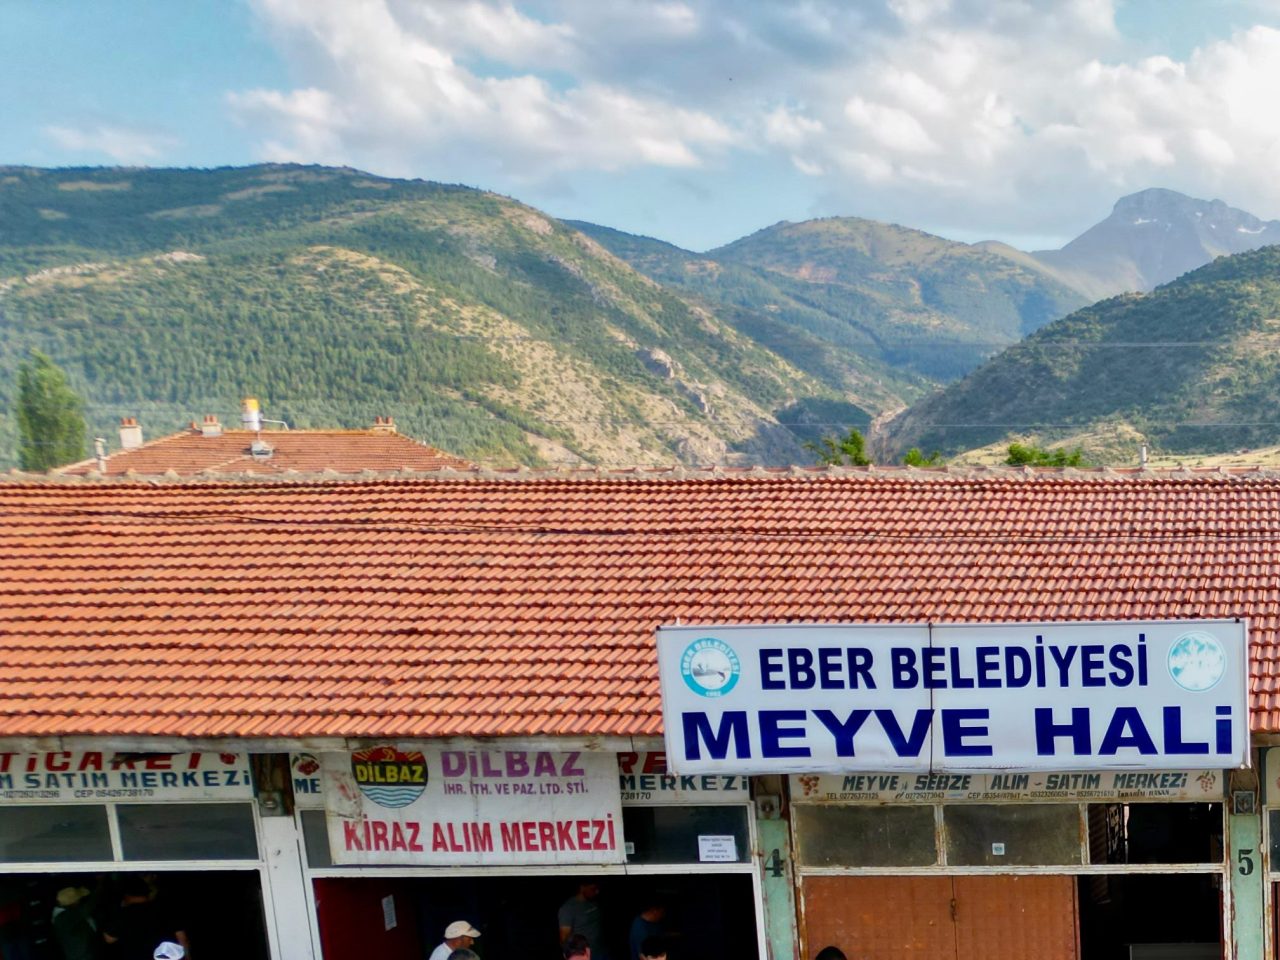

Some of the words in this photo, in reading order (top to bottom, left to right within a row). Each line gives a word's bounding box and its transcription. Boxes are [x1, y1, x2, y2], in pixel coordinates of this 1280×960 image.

[759, 648, 877, 690] EBER
[891, 633, 1148, 689] BELEDİYESİ
[681, 709, 993, 761] MEYVE
[24, 772, 108, 789] SATIM
[495, 783, 510, 794] VE
[513, 783, 536, 795] PAZ.
[540, 783, 563, 794] LTD.
[842, 775, 899, 791] MEYVE
[914, 775, 971, 790] SEBZE
[990, 774, 1029, 790] ALIM
[1046, 774, 1101, 790] SATIM
[74, 790, 94, 798] CEP
[343, 815, 423, 851] KİRAZ
[432, 822, 493, 852] ALIM
[500, 814, 616, 851] MERKEZİ
[765, 848, 784, 877] 4
[1237, 849, 1254, 875] 5
